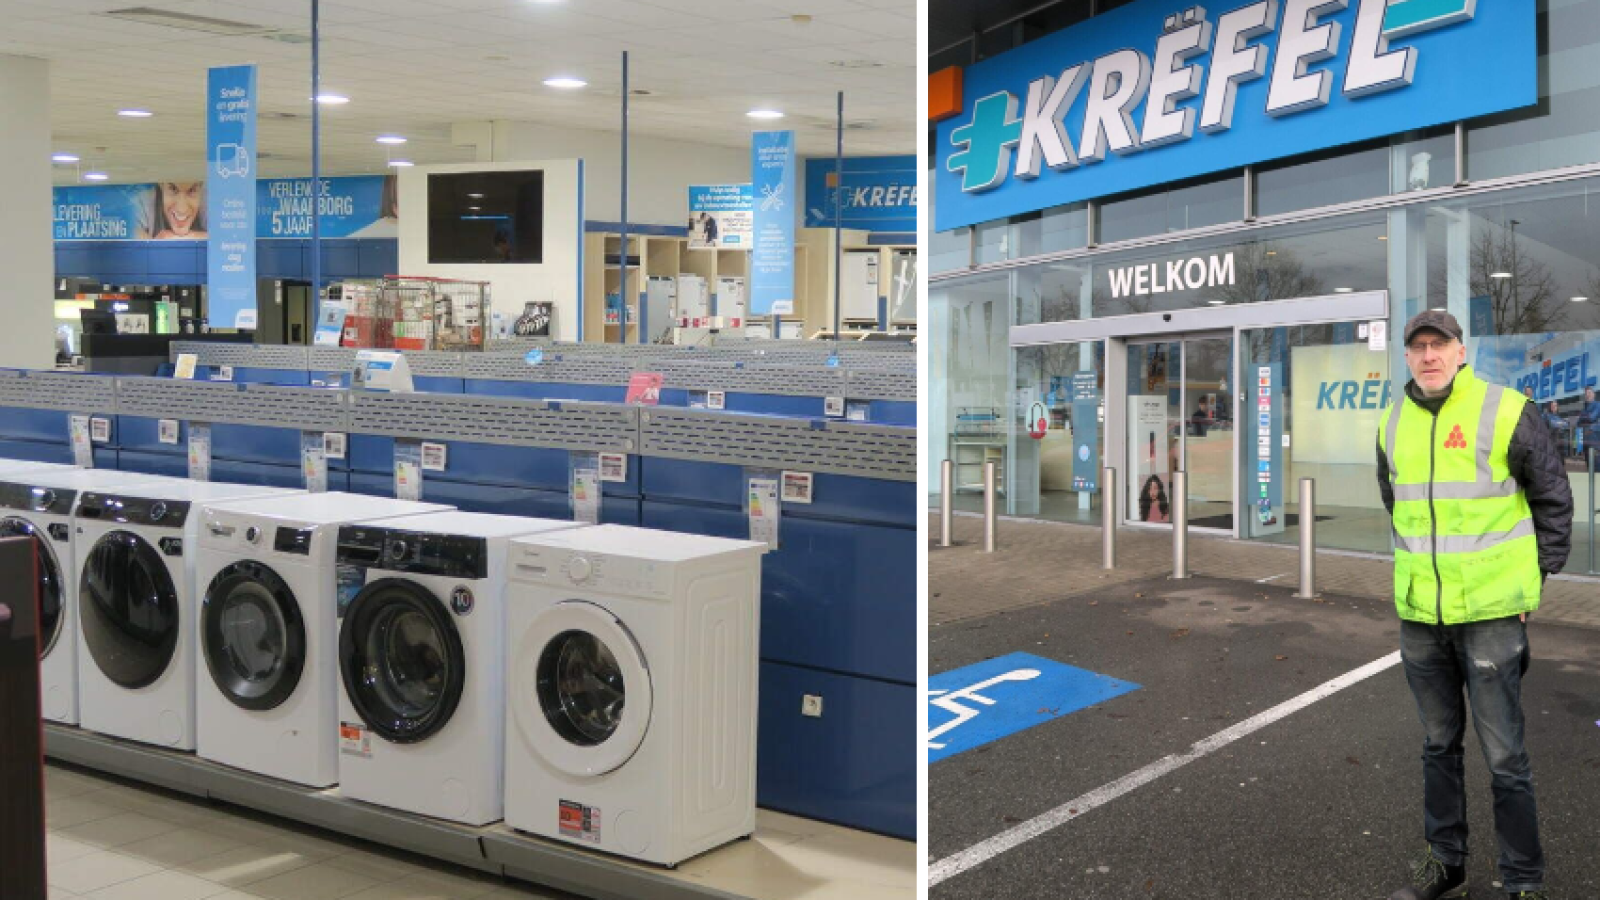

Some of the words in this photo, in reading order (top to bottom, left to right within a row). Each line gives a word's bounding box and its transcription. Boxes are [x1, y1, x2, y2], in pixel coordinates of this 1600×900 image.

[1014, 0, 1419, 180] KRËFEL
[68, 219, 127, 238] PLAATSING
[272, 211, 282, 235] 5
[1108, 252, 1236, 298] WELKOM
